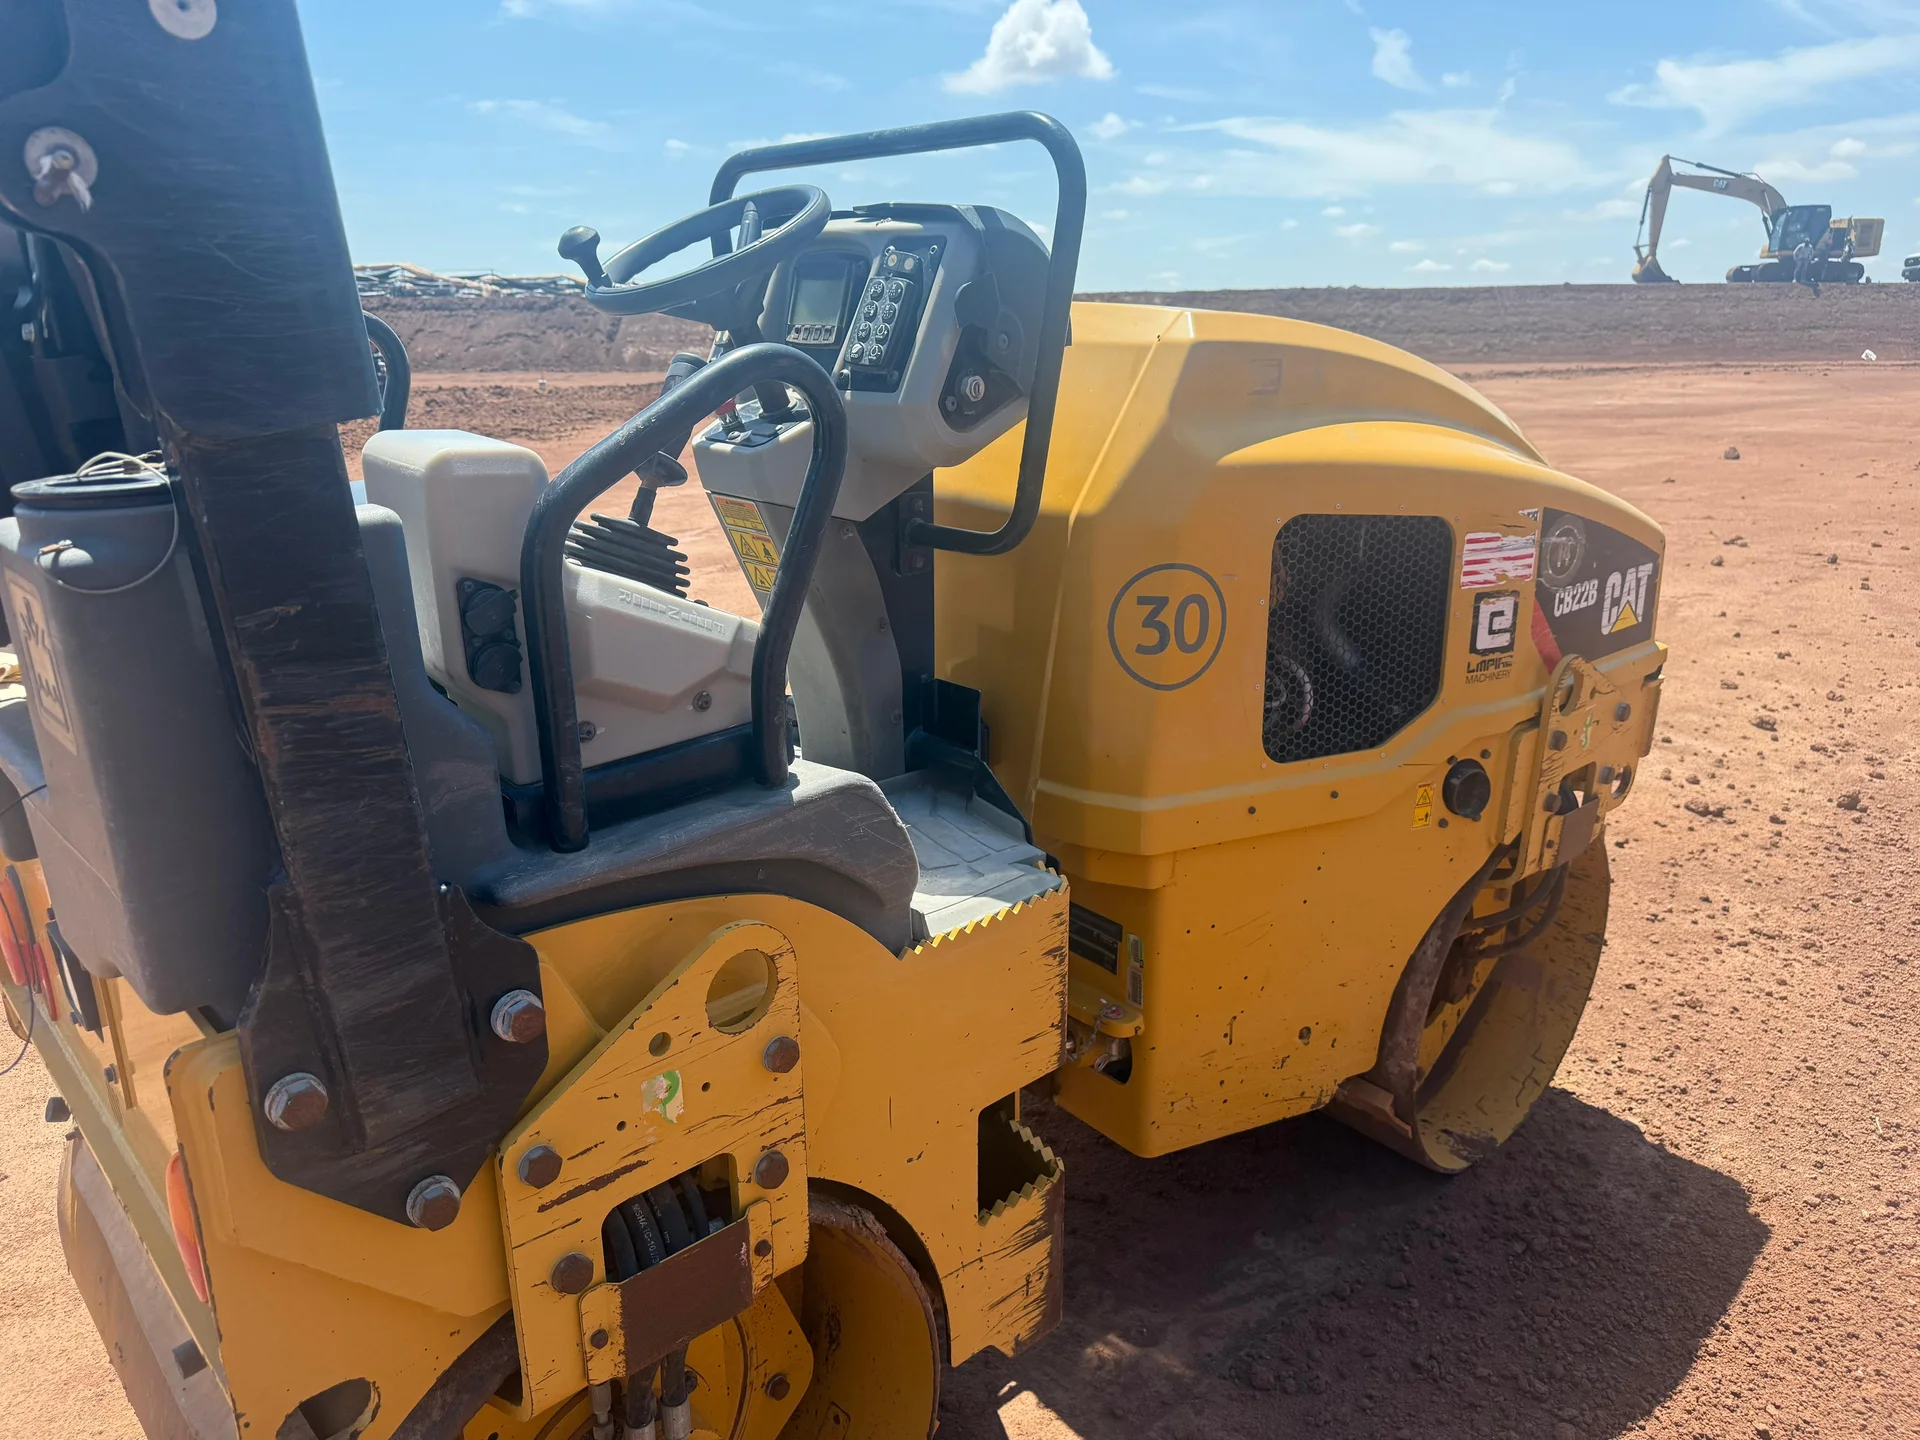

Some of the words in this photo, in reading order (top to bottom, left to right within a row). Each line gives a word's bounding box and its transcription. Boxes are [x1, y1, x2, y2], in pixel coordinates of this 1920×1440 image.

[1713, 178, 1727, 189] CAT
[1553, 578, 1599, 618] CB22B
[1601, 563, 1653, 635] CAT
[1135, 593, 1210, 655] 30
[1465, 669, 1512, 684] MACHINERY
[632, 1203, 647, 1228] MSHA
